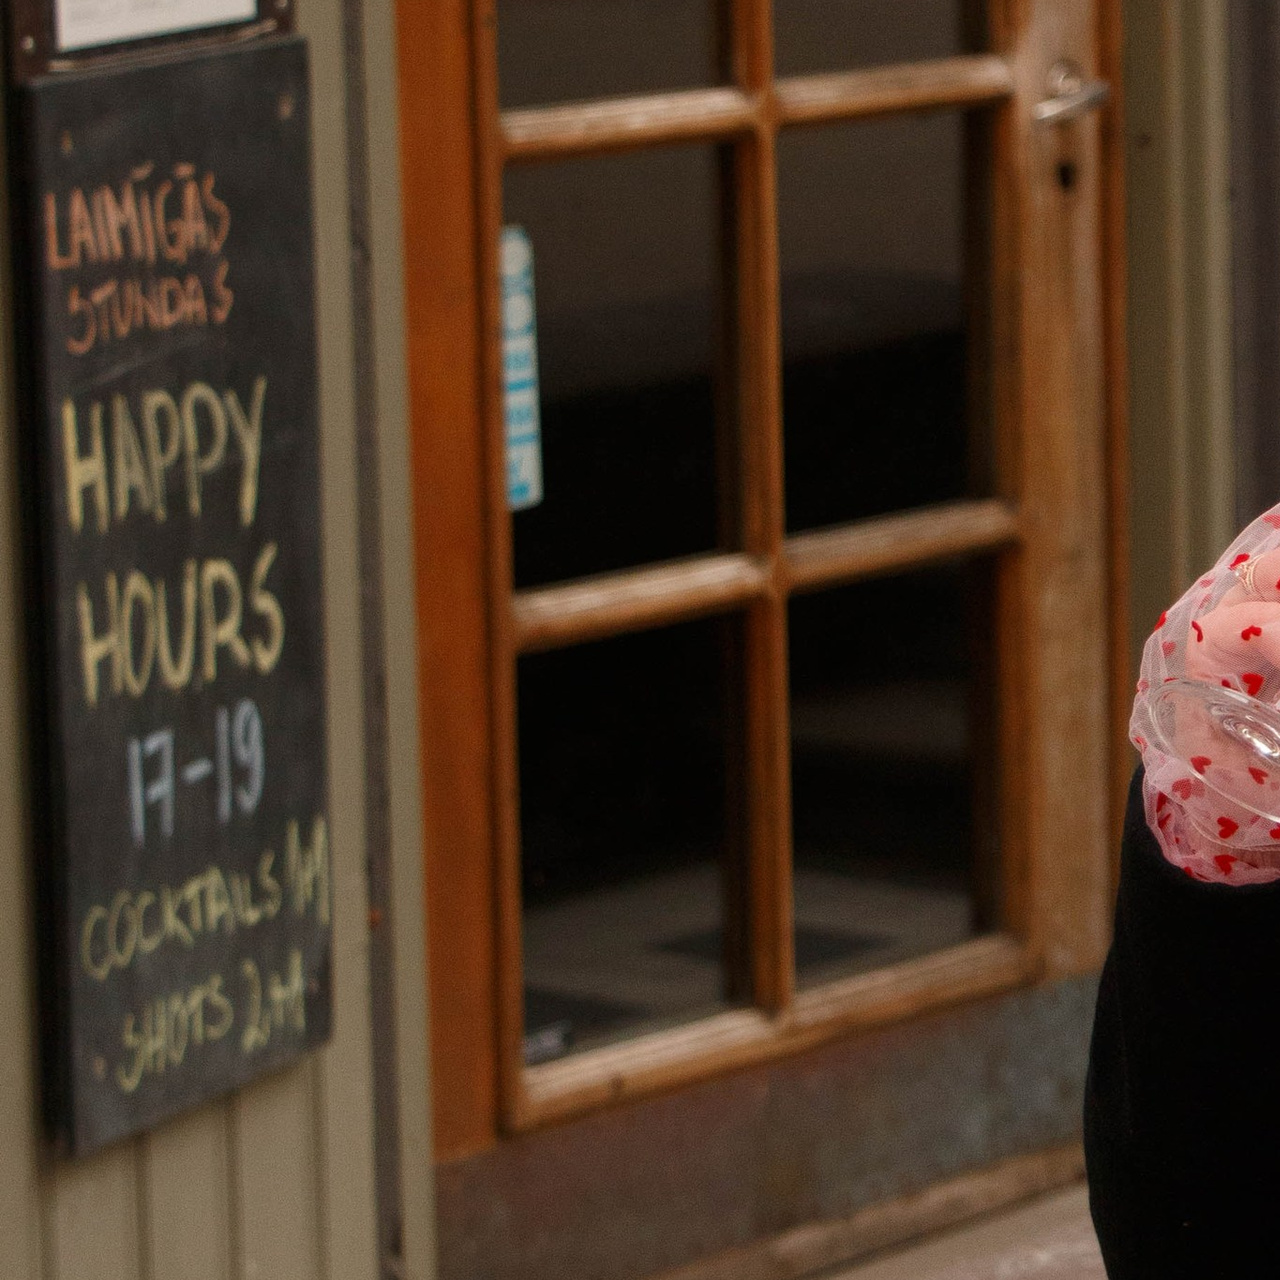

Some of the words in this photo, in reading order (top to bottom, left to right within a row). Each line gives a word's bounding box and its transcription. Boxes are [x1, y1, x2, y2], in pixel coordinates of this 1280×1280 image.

[66, 261, 233, 354] STUNDAS
[62, 376, 266, 533] HAPPY
[78, 542, 284, 707] HOURS
[128, 697, 265, 847] 17-19
[82, 849, 282, 980] COCKTAILS
[118, 973, 234, 1091] SHOTS
